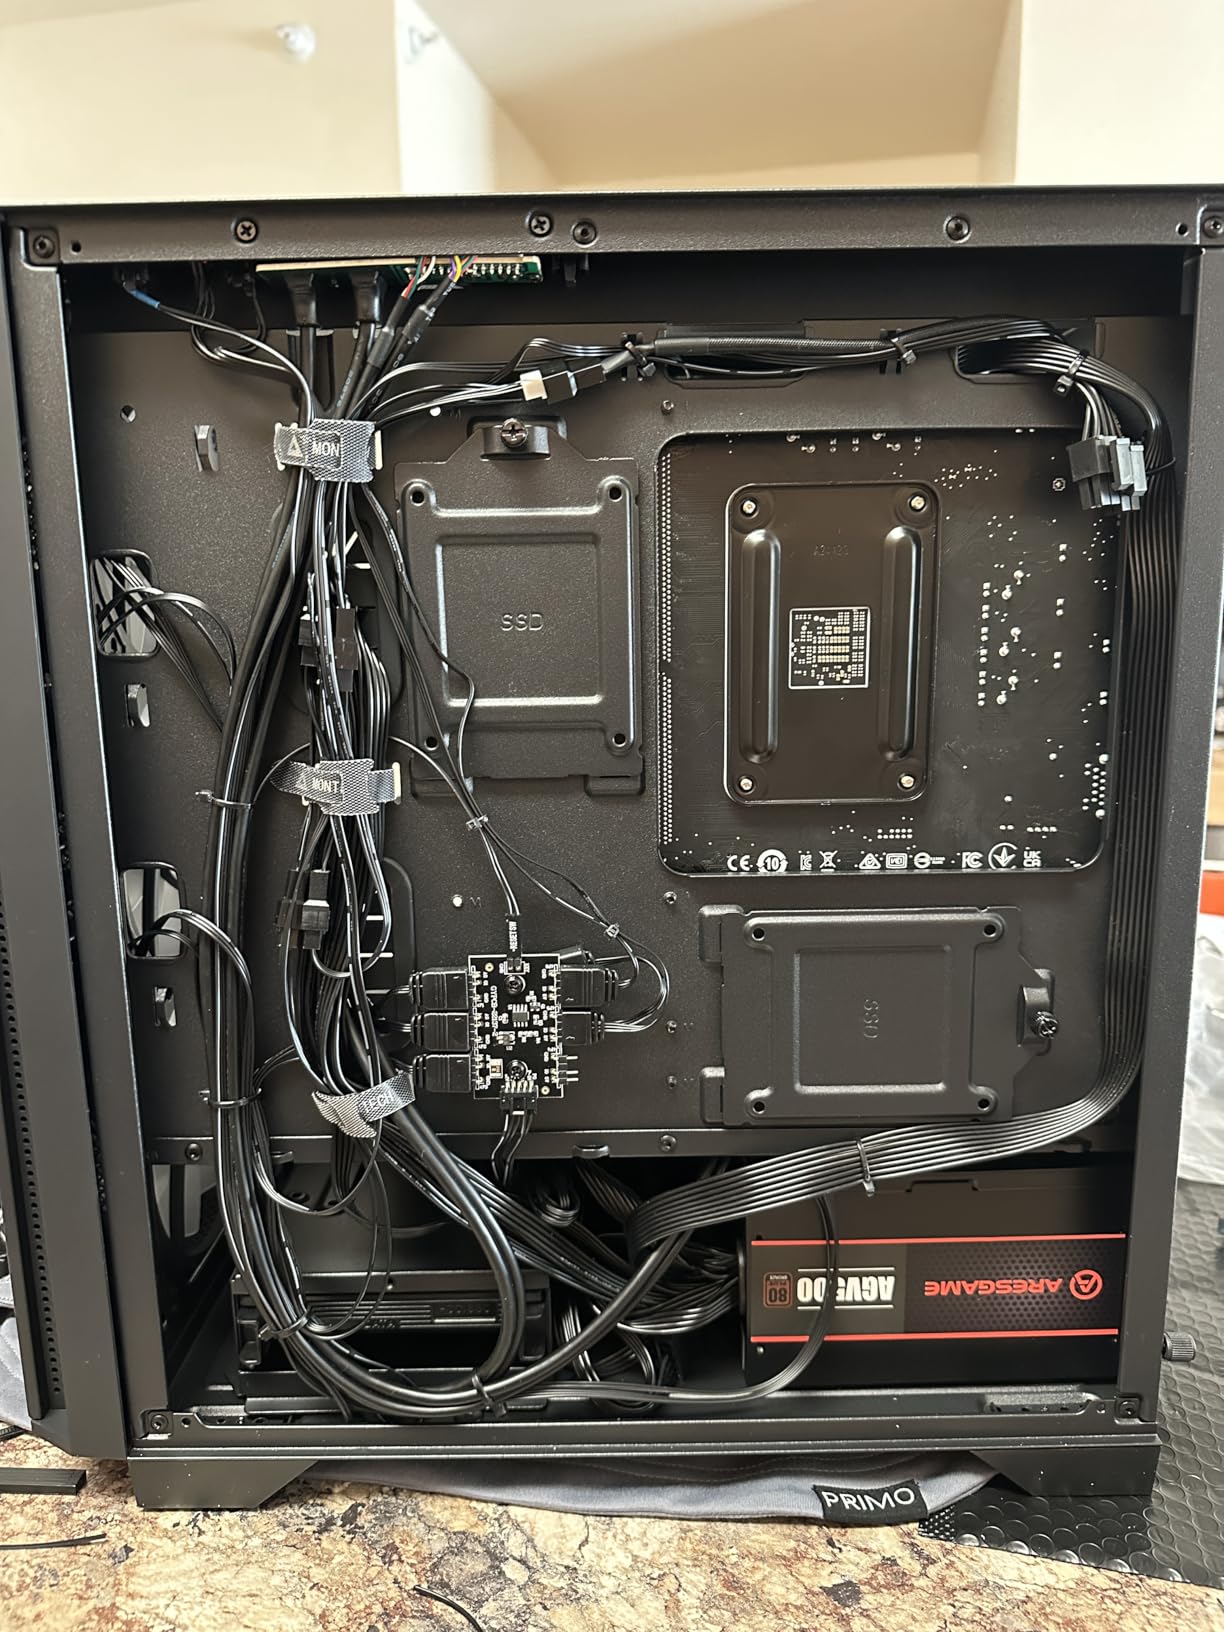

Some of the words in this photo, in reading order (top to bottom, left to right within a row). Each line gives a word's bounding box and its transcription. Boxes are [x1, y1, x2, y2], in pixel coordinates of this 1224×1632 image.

[500, 613, 544, 632] SSD
[726, 855, 751, 872] CE
[1023, 850, 1041, 859] UK
[1023, 859, 1041, 868] CA
[863, 999, 880, 1039] SSD
[768, 1287, 787, 1303] 80
[923, 1278, 1063, 1297] ARESGAME
[821, 1487, 915, 1511] PRIMO
